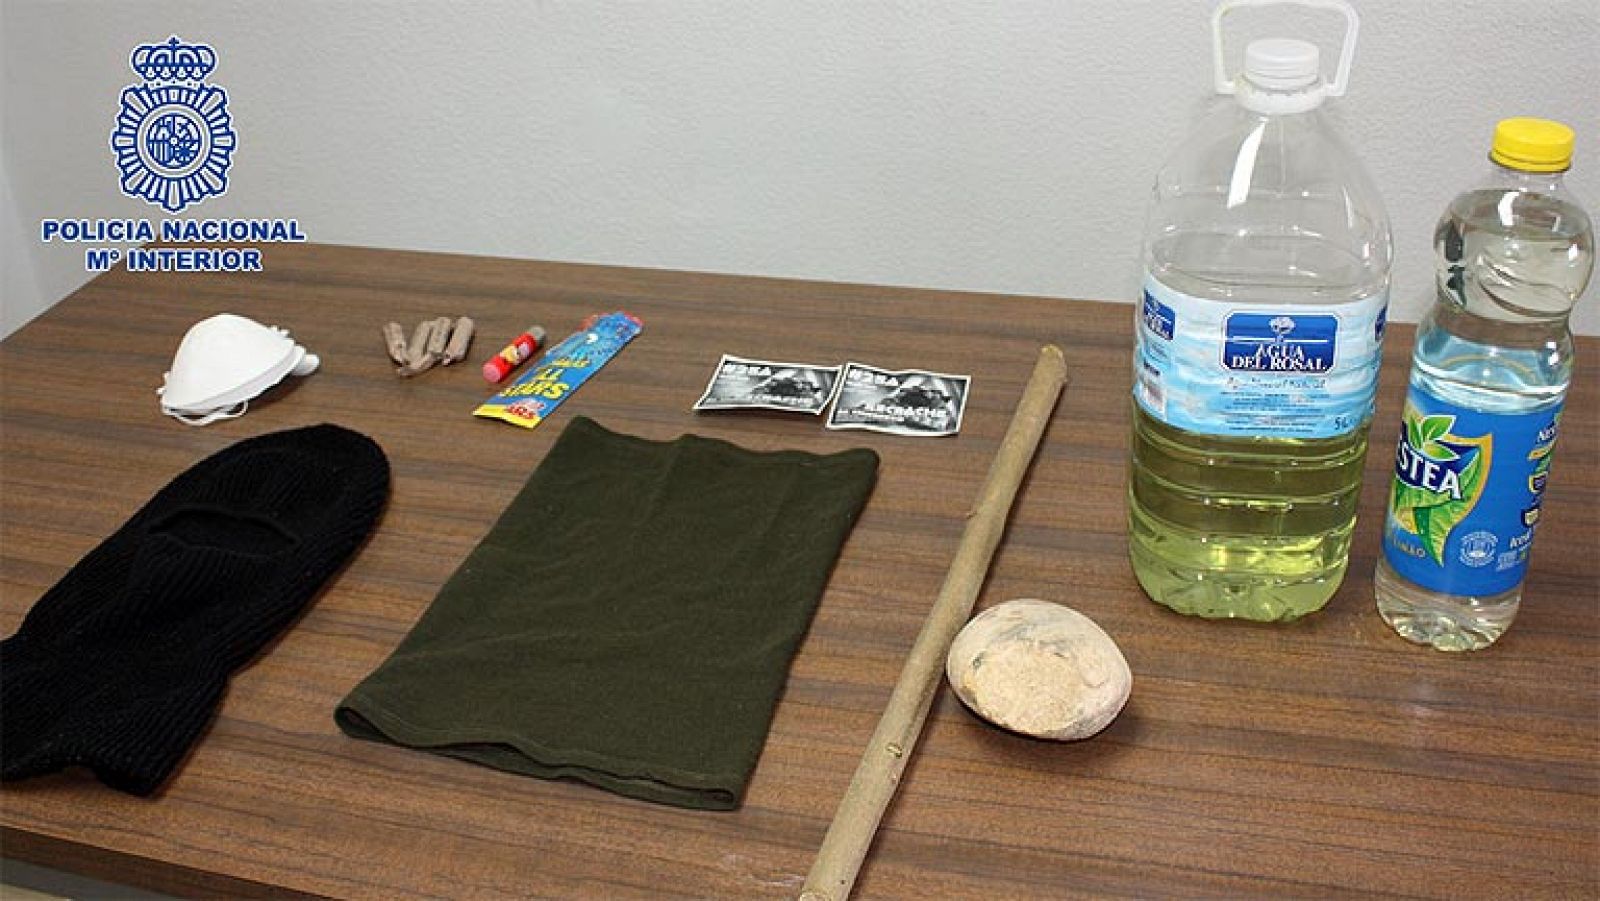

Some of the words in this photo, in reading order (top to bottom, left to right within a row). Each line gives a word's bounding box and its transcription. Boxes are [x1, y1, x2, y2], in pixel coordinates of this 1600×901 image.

[1255, 344, 1304, 361] AGUA
[1231, 356, 1267, 370] DEL
[1270, 356, 1327, 370] ROSAL
[1398, 441, 1461, 499] STEA
